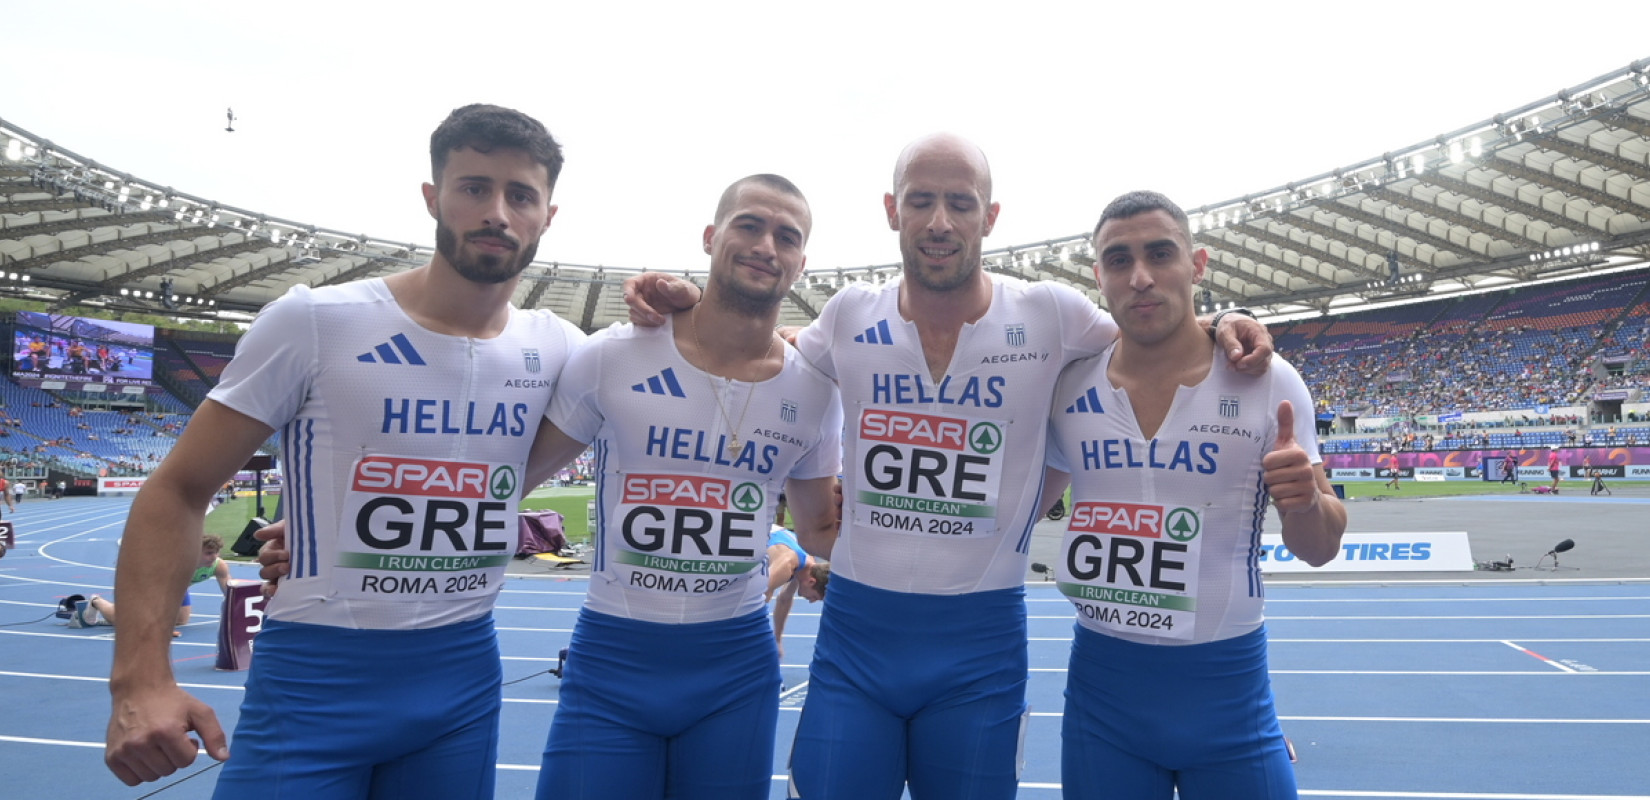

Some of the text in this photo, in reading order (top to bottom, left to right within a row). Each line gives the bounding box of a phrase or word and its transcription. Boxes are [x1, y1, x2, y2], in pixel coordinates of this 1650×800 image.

[981, 352, 1037, 364] AEGEAN
[504, 379, 550, 388] AEGEAN
[873, 373, 1006, 408] HELLAS
[381, 398, 528, 437] HELLAS
[863, 413, 963, 446] SPAR
[753, 428, 803, 447] AEGEAN
[1188, 424, 1251, 439] AEGEAN
[646, 425, 780, 474] HELLAS
[1080, 438, 1220, 475] HELLAS
[357, 461, 486, 494] SPAR
[864, 444, 990, 502] GRE
[626, 478, 728, 505] SPAR
[886, 496, 914, 510] RUN
[355, 496, 508, 551] GRE
[622, 505, 755, 557] GRE
[870, 511, 974, 535] ROMA 2024
[1071, 506, 1159, 533] SPAR
[387, 556, 428, 570] RUN
[651, 556, 679, 570] RUN
[1066, 534, 1188, 592] GRE
[1343, 542, 1431, 561] TIRES
[361, 573, 488, 594] ROMA 2024
[630, 571, 688, 593] ROMA
[1086, 587, 1112, 601] RUN
[245, 595, 264, 633] 5
[1126, 610, 1174, 631] 2024
